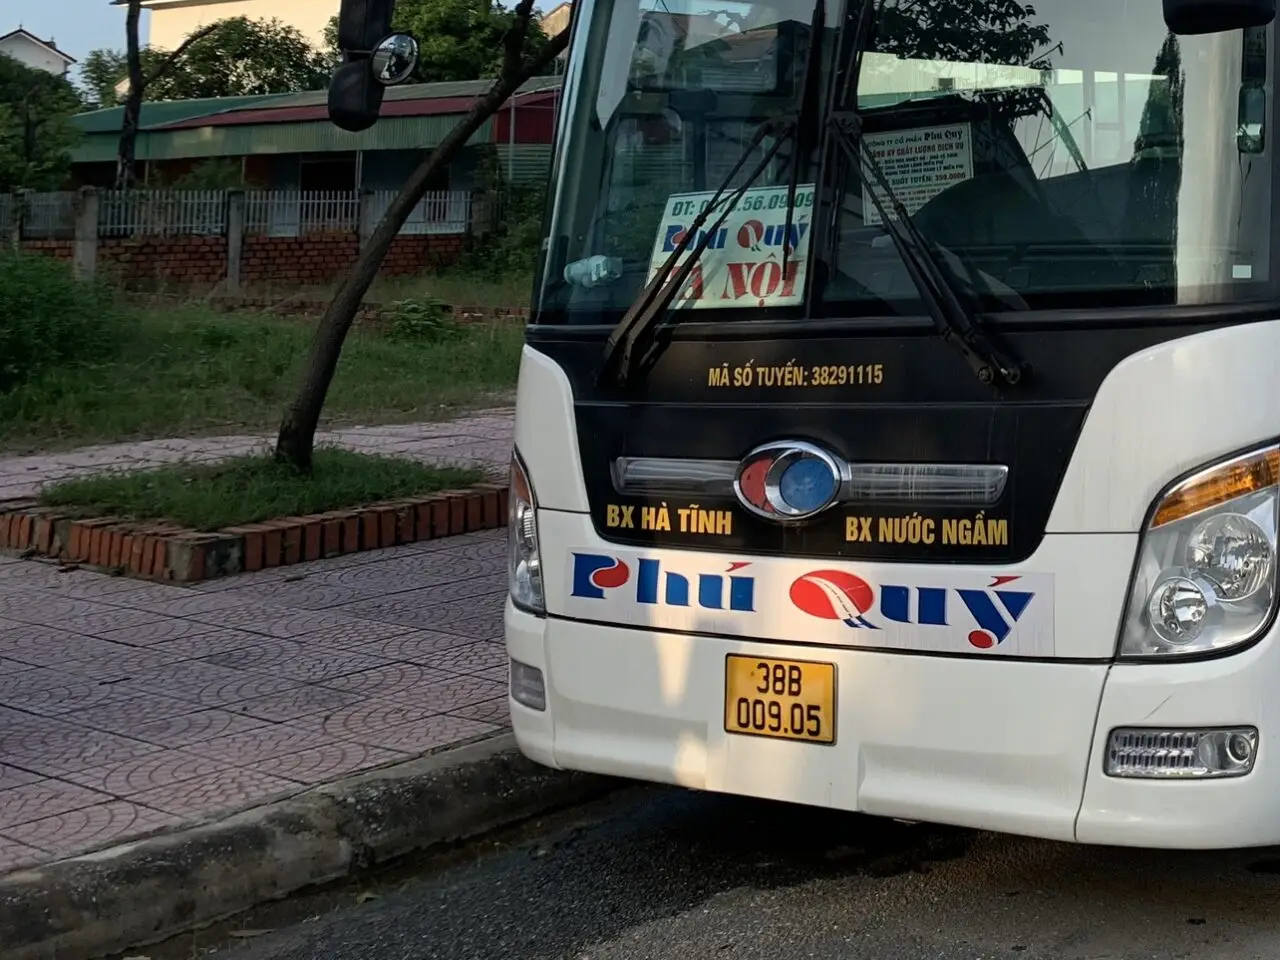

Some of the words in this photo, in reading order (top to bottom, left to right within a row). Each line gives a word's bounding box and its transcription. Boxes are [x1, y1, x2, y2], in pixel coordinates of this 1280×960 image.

[672, 200, 695, 217] ĐT:
[720, 252, 805, 308] NỘI
[708, 365, 731, 387] MÃ
[733, 361, 753, 387] SỐ
[756, 360, 808, 387] TUYẾN:
[811, 364, 884, 386] 38291115
[607, 504, 635, 528] BX
[641, 504, 671, 533] HÀ
[677, 507, 732, 536] TĨNH
[845, 517, 872, 543] BX
[878, 514, 935, 545] NƯỚC
[941, 513, 1008, 546] NGẦM
[570, 552, 757, 612] Phú
[789, 568, 1036, 649] Quý
[756, 663, 801, 697] 38B
[736, 697, 821, 737] 009.05
